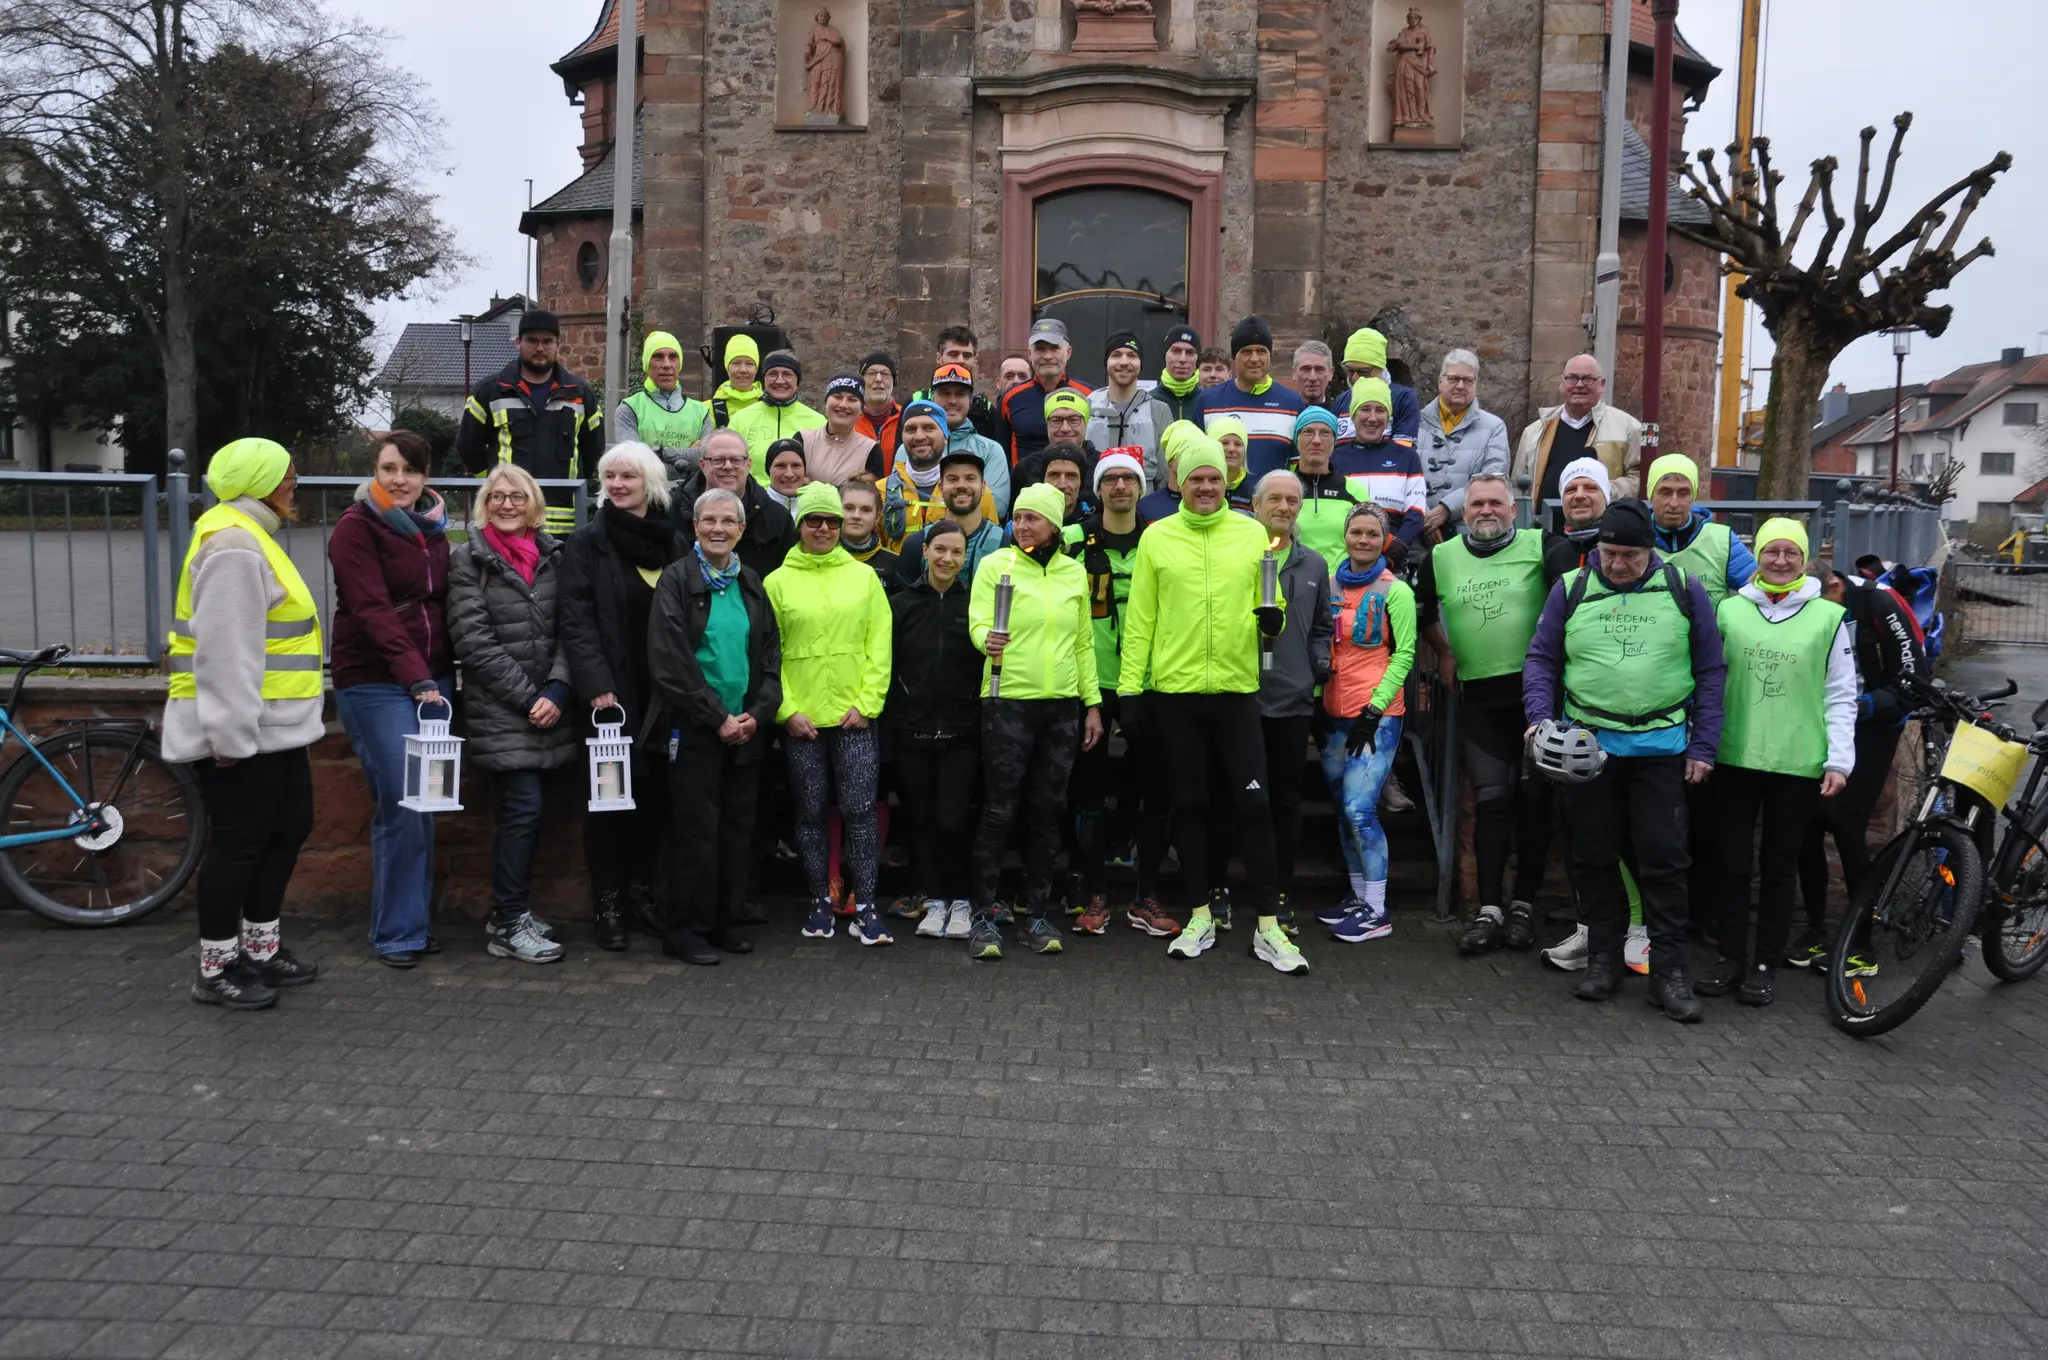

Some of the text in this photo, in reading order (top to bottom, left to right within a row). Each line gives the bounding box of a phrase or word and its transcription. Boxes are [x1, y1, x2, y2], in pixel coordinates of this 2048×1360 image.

[656, 430, 692, 441] FREDENS
[1456, 578, 1510, 595] FRIEDENS
[1462, 590, 1495, 605] LICHT
[1600, 612, 1657, 625] FRIEDENS
[1604, 624, 1640, 634] LICHT
[1743, 647, 1797, 664] FRIEDENS
[1747, 660, 1781, 672] LICHT
